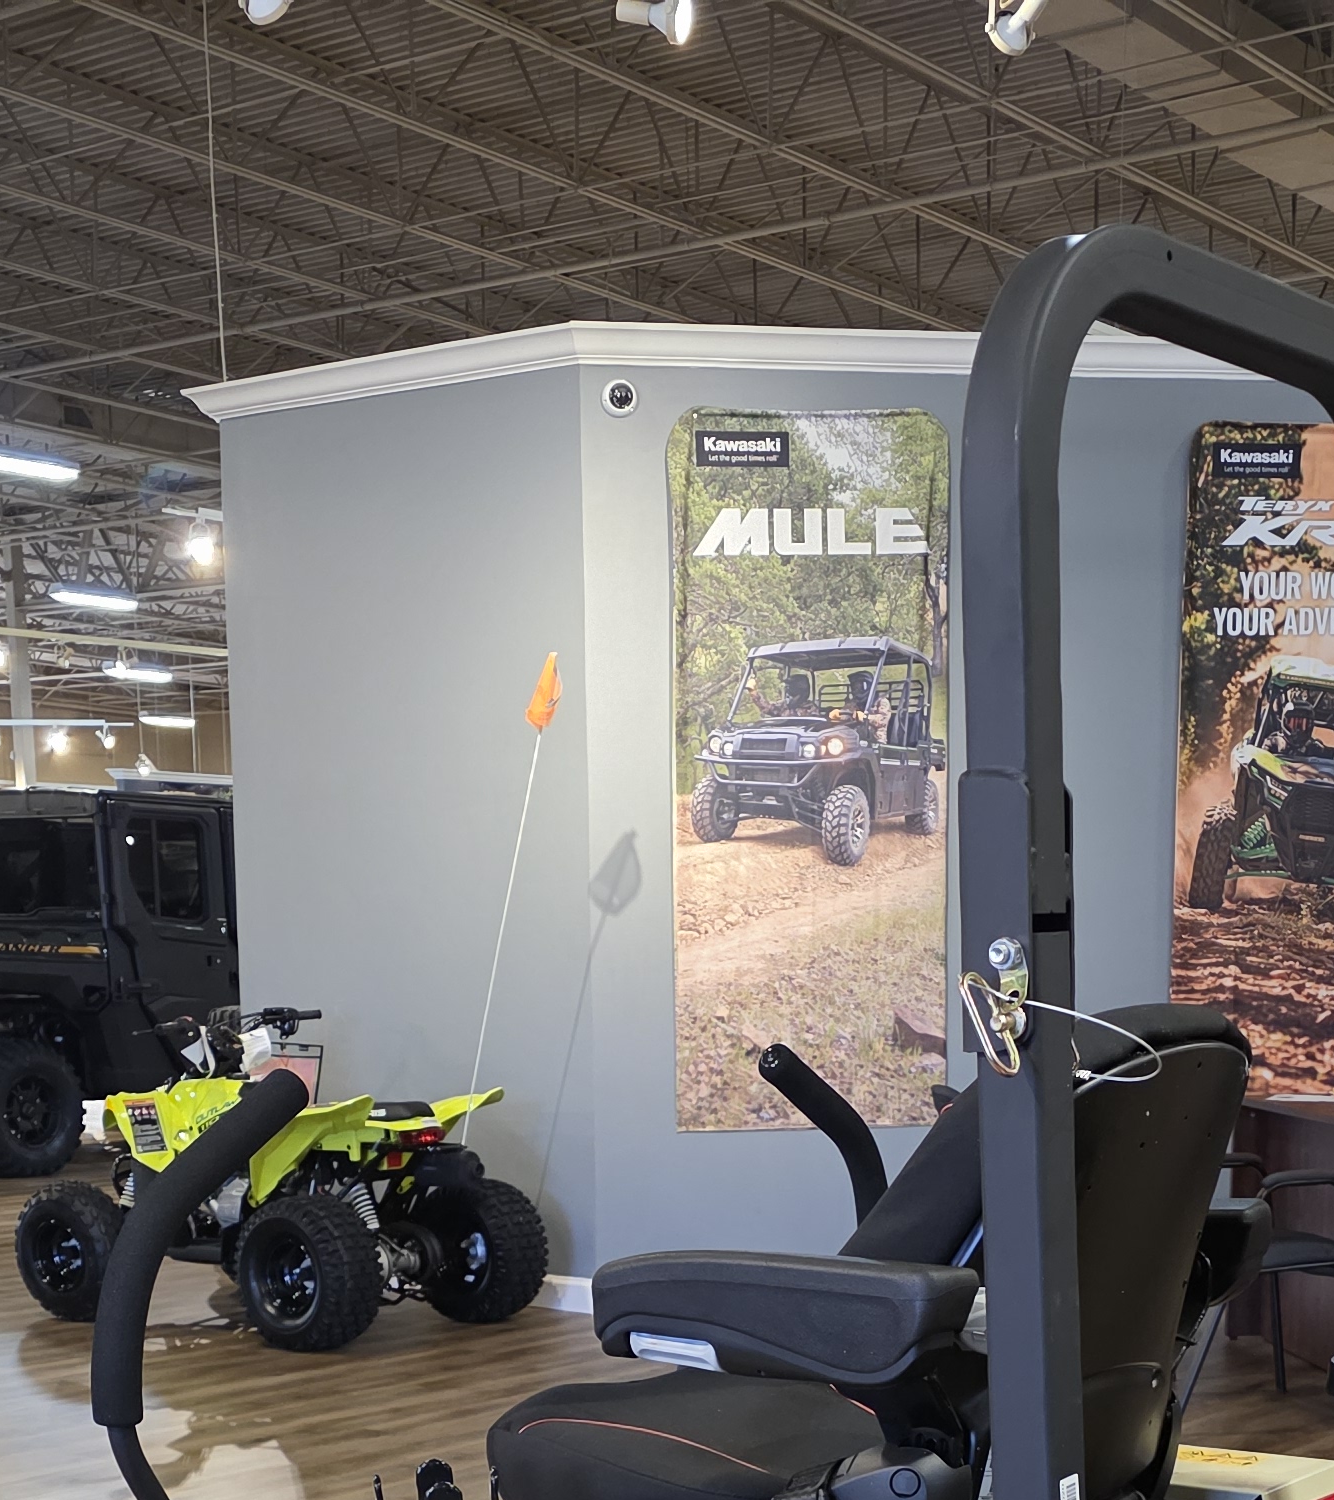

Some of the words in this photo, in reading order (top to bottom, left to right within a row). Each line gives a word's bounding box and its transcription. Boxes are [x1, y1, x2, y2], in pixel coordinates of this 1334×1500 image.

[703, 436, 781, 452] Kawasaki
[708, 454, 718, 462] Let
[719, 454, 730, 462] the
[731, 454, 747, 463] good
[748, 454, 766, 462] times
[1220, 448, 1294, 464] Kawasaki
[1224, 465, 1233, 473] Let
[1245, 466, 1261, 474] good
[692, 507, 930, 556] MULE
[1239, 571, 1302, 600] YOUR
[1213, 607, 1276, 636] YOUR
